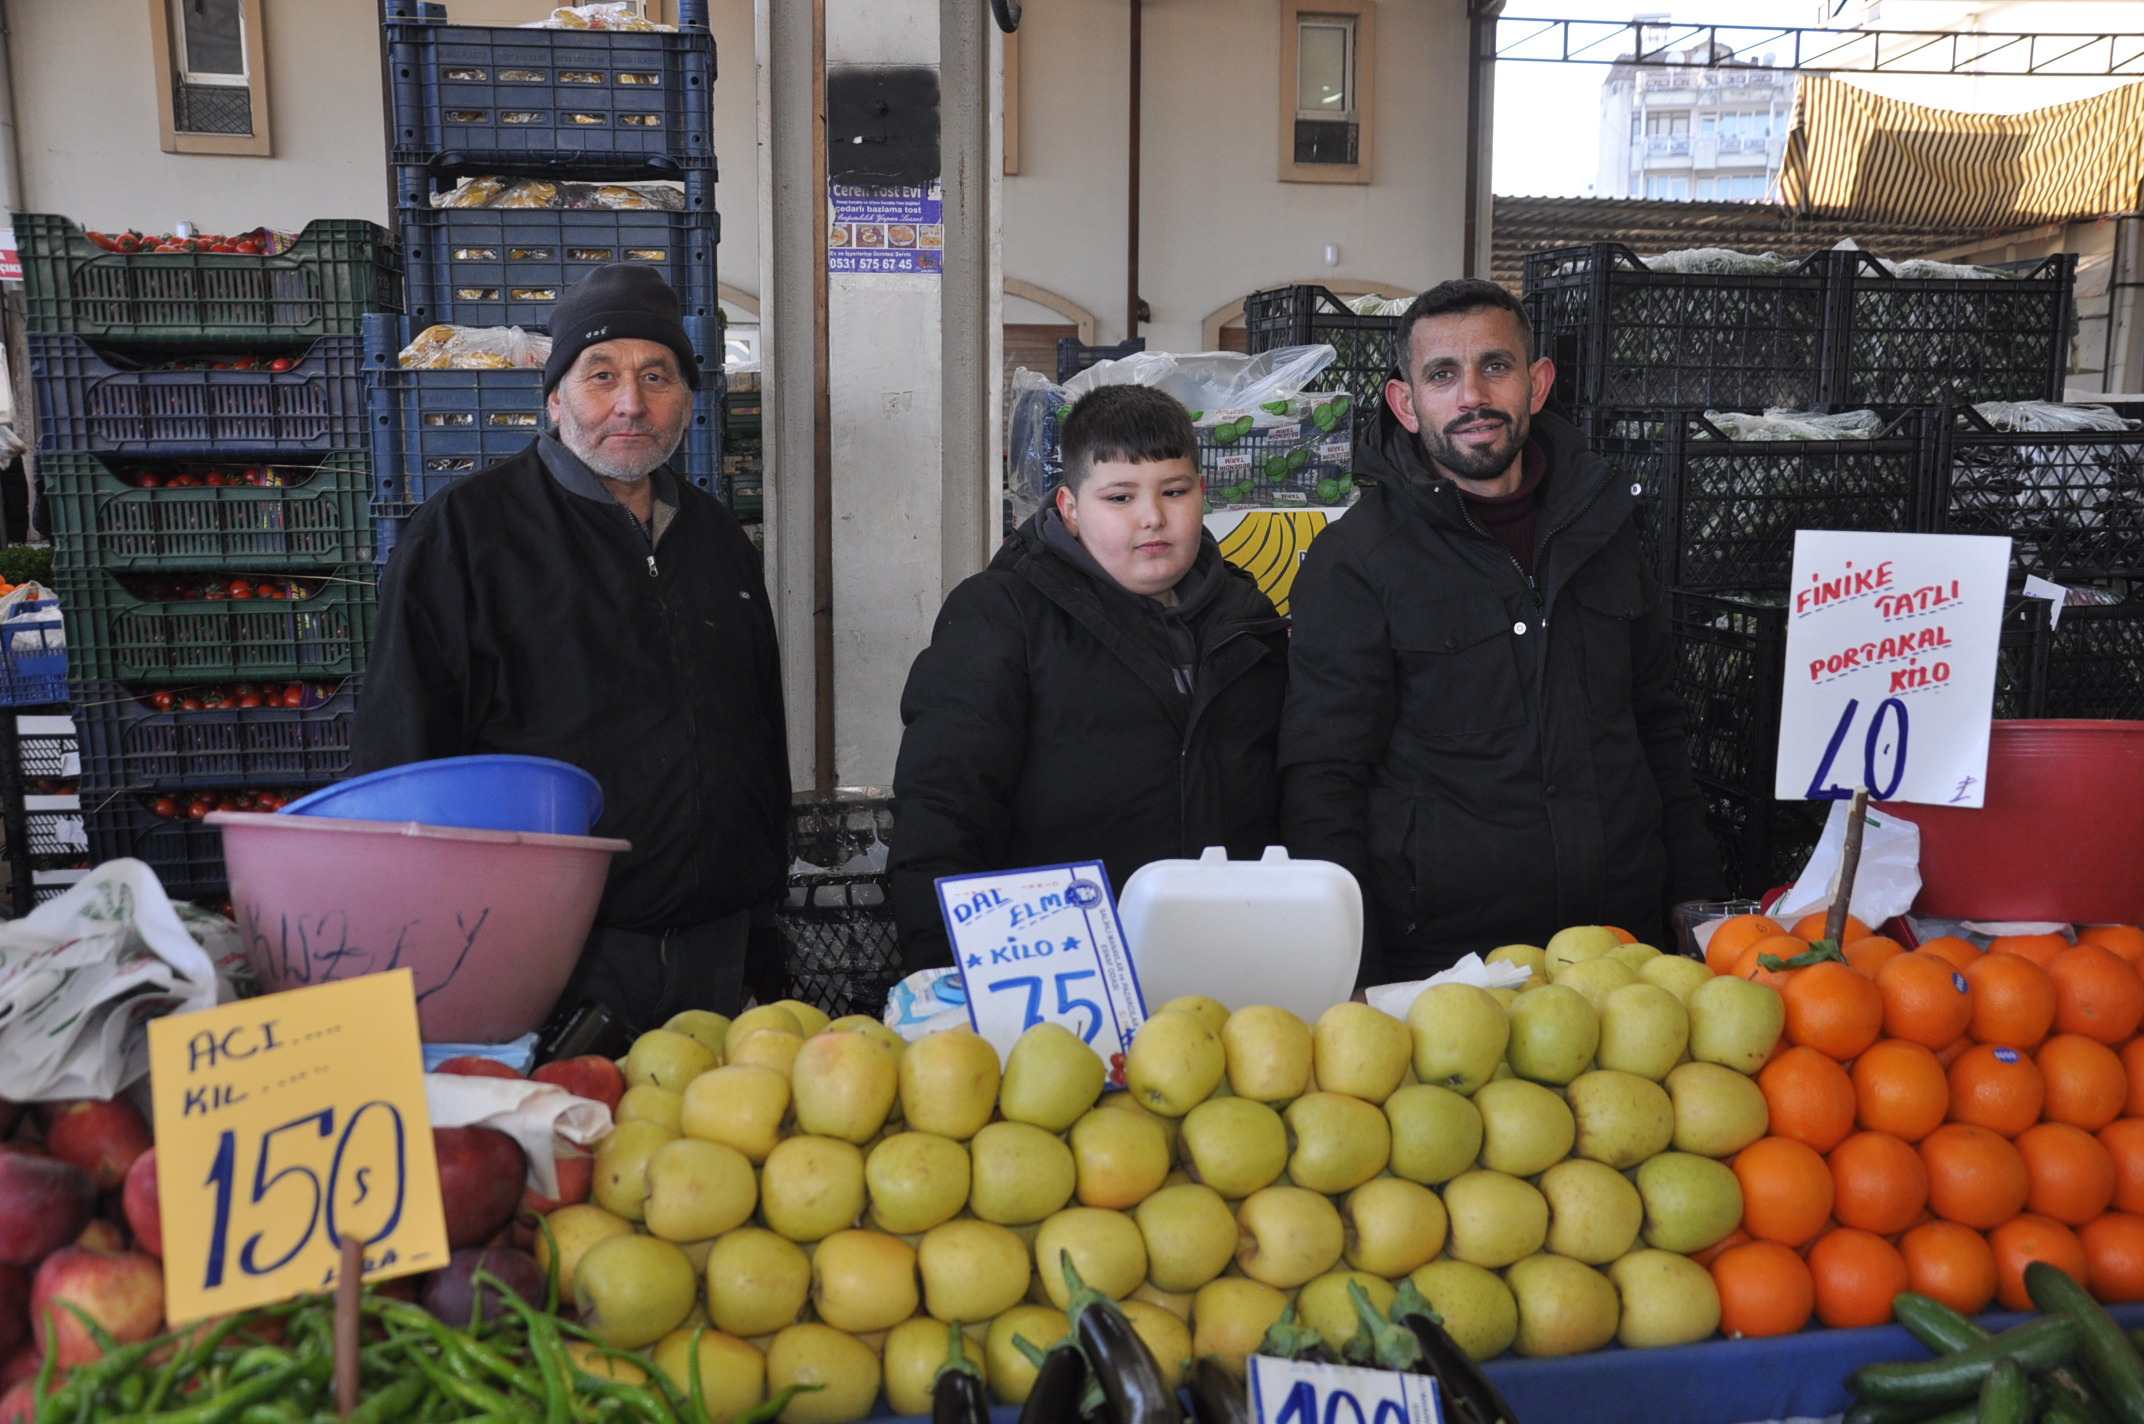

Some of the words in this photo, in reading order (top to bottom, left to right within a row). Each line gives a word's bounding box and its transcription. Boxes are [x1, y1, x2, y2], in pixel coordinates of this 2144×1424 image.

[872, 184, 899, 198] Tost
[903, 185, 921, 198] Evi
[904, 206, 922, 214] tost
[830, 258, 856, 269] 0531
[859, 258, 879, 269] 575
[882, 259, 896, 269] 67
[899, 259, 912, 269] 45
[1224, 457, 1245, 465] TARIM
[1796, 561, 1893, 614] FİNİKE
[1874, 580, 1959, 618] TATLI
[1809, 626, 1952, 681] PORTAKAL
[1889, 657, 1950, 693] KİLO
[953, 888, 1012, 923] DAL
[989, 936, 1054, 964] KİLO
[987, 969, 1103, 1046] 75
[204, 1100, 406, 1290] 150
